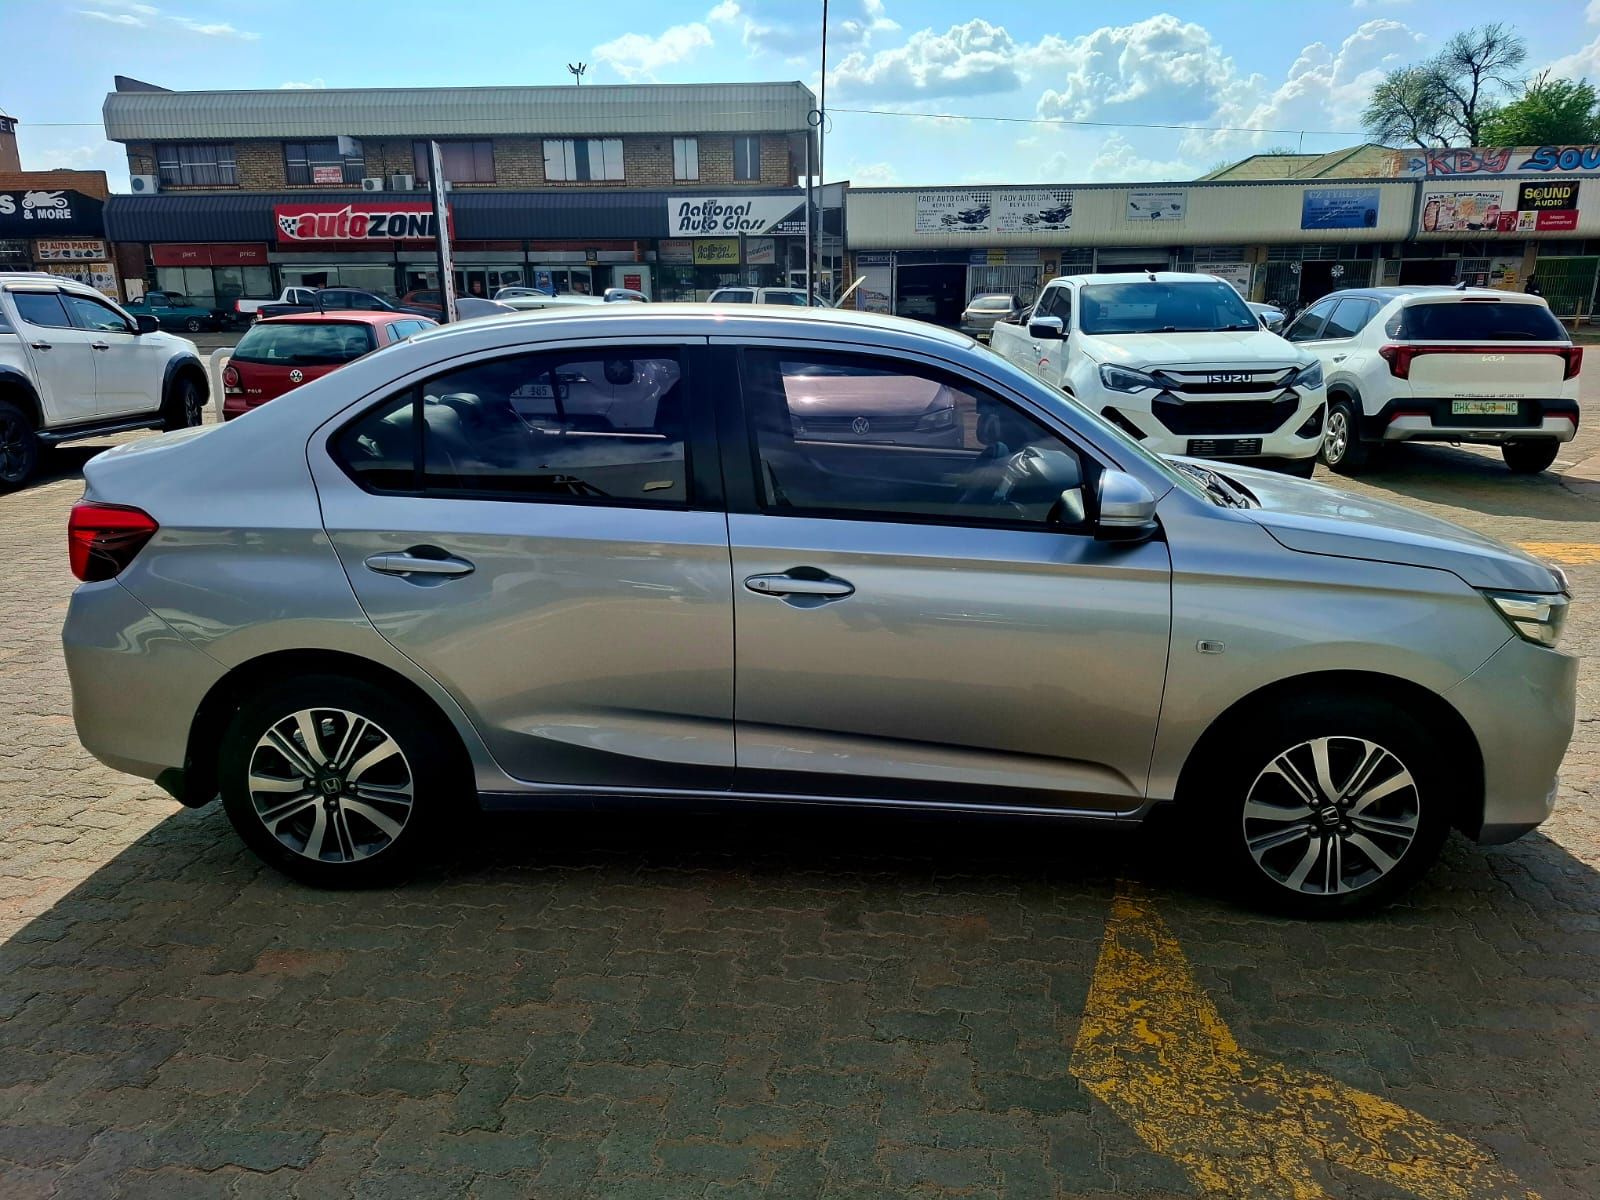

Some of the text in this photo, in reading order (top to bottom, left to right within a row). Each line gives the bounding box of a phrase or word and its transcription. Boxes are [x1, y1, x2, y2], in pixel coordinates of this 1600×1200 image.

[1524, 187, 1571, 200] SOUND
[37, 208, 72, 219] MORE
[678, 201, 752, 217] National
[678, 216, 766, 233] Auto Glass
[239, 250, 256, 258] price
[1208, 374, 1252, 383] ISUZU
